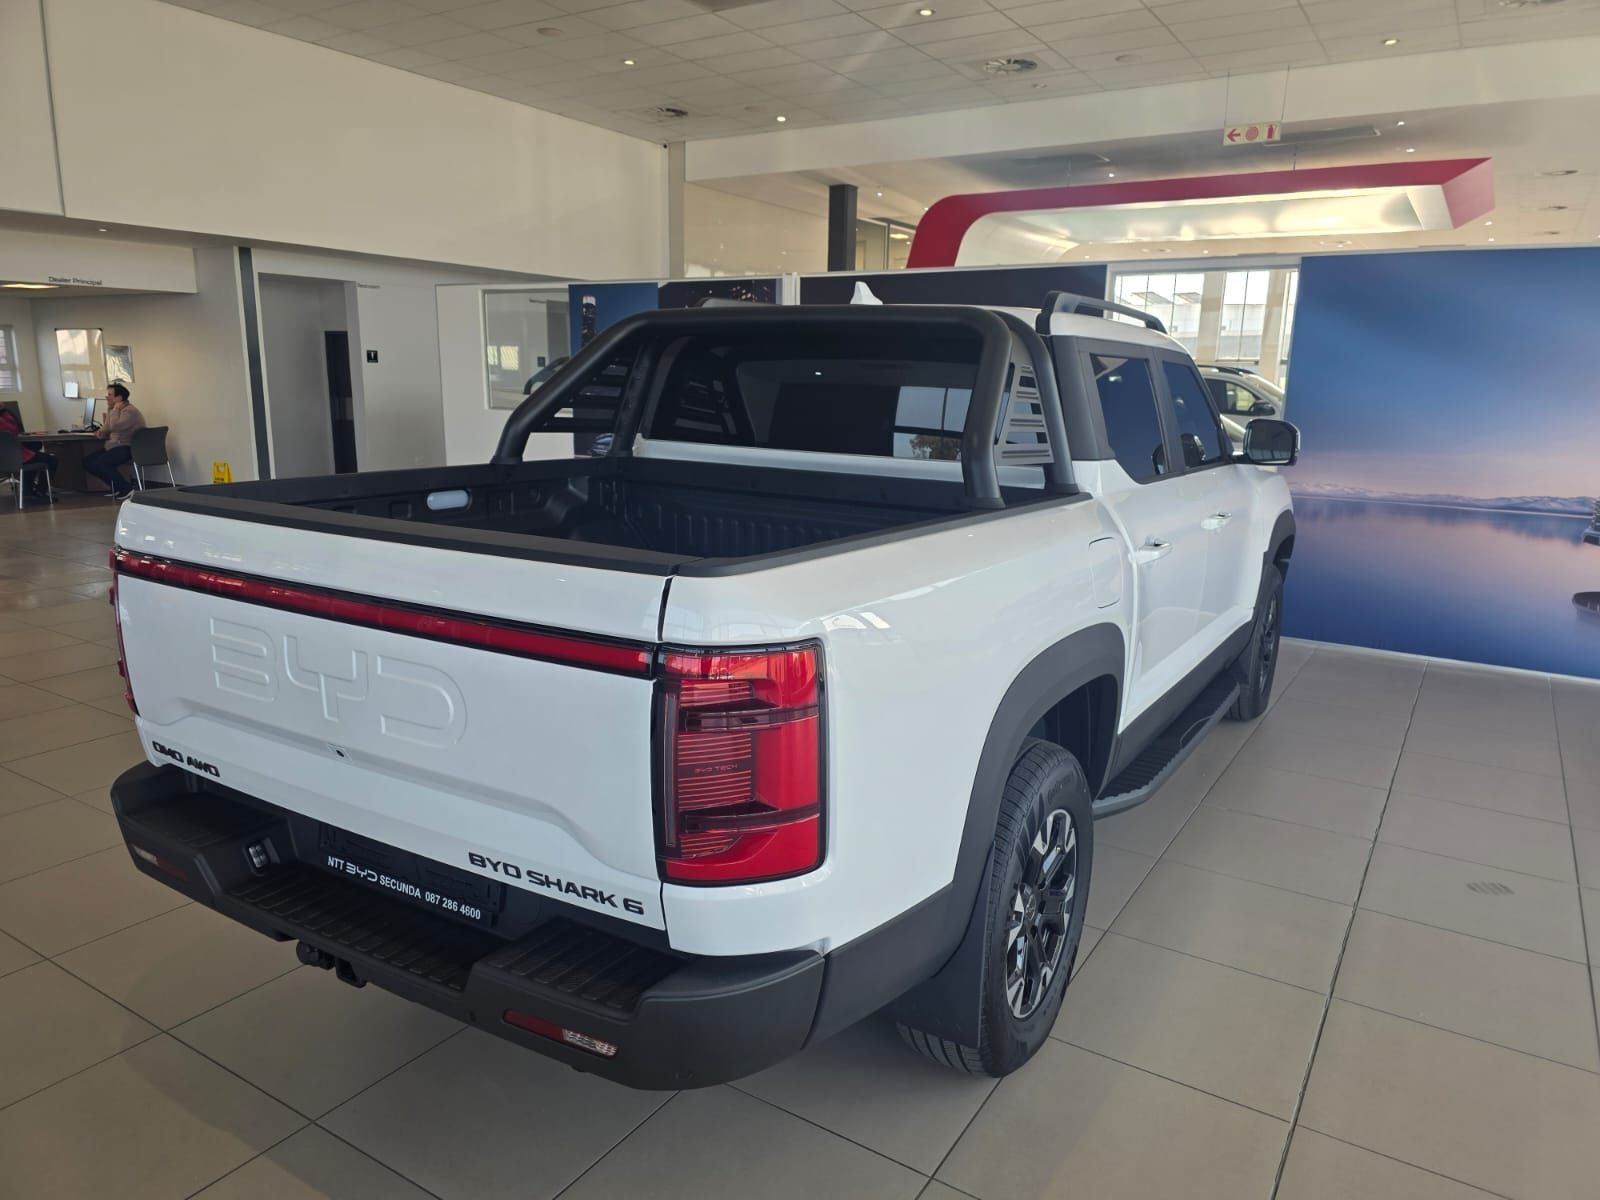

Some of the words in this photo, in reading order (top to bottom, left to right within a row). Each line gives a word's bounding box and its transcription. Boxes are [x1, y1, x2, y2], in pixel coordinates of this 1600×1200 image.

[210, 617, 468, 749] BYD
[327, 855, 345, 870] NTT
[346, 862, 378, 882] BYD
[379, 875, 422, 898] SECUNDA
[425, 891, 441, 905] 087
[442, 897, 458, 912] 286
[459, 904, 481, 920] 4600
[468, 852, 522, 879] BYD
[526, 870, 618, 908] SHARK
[622, 898, 645, 915] 6
